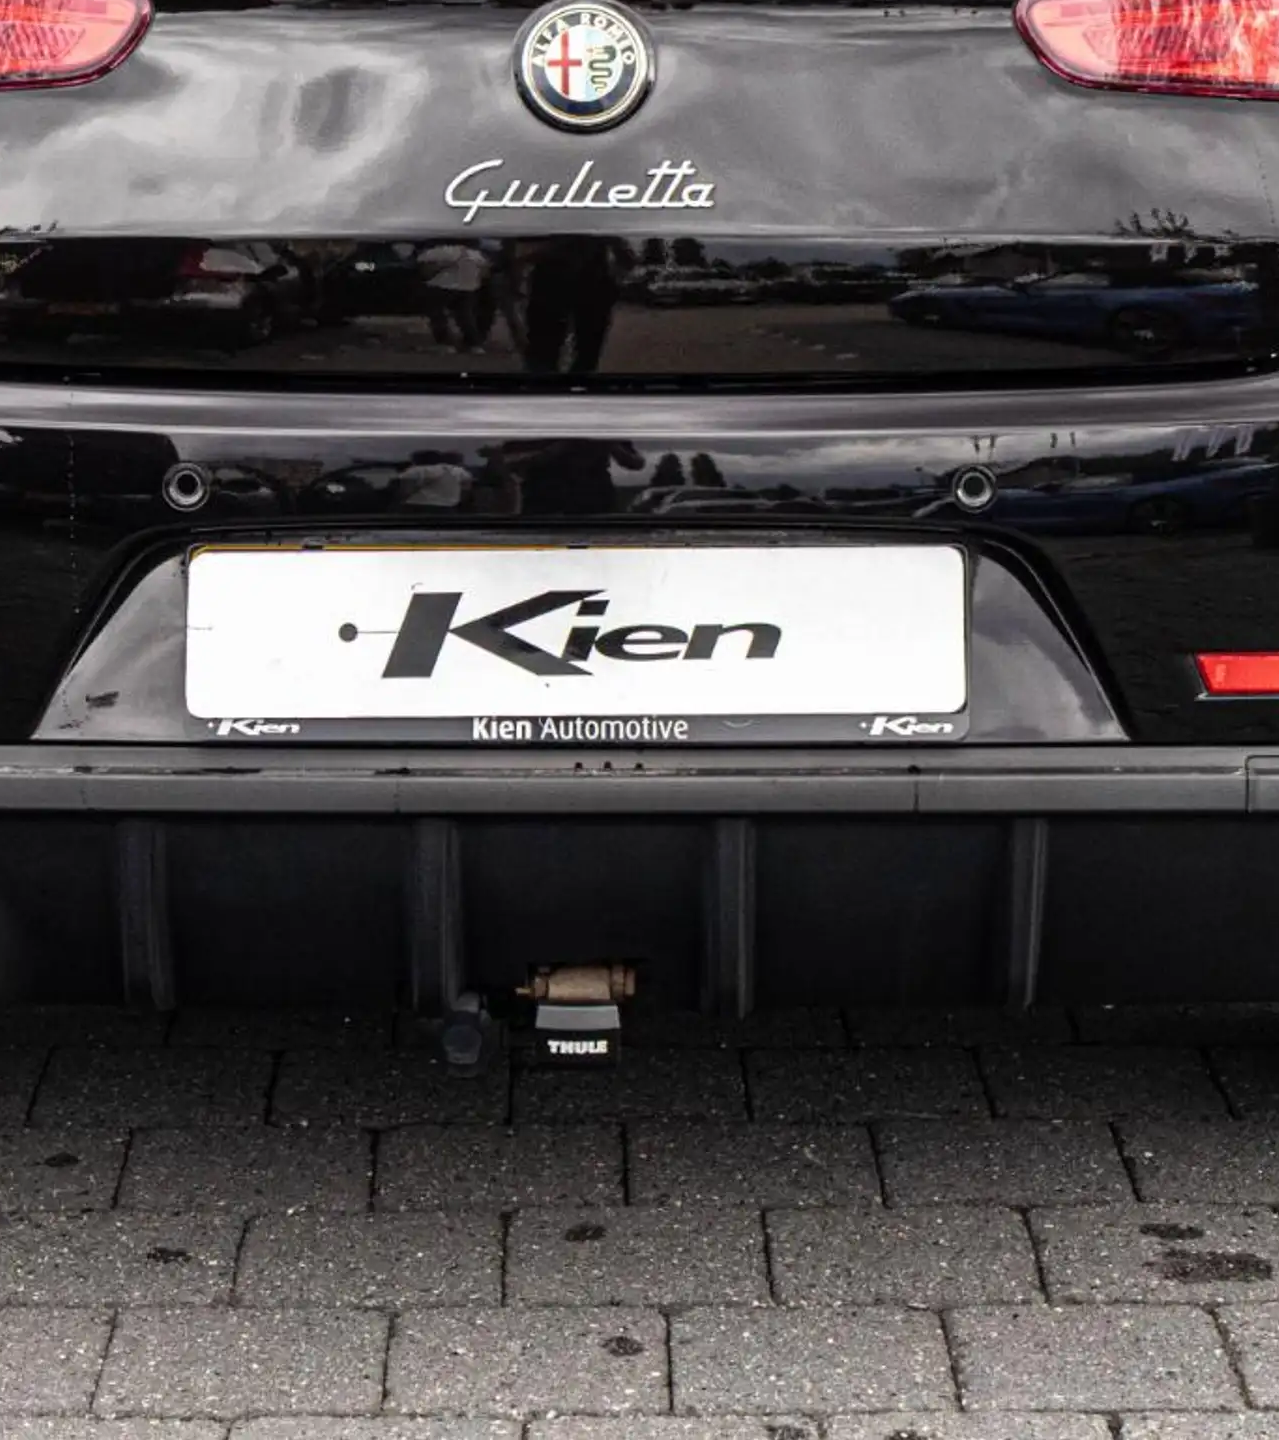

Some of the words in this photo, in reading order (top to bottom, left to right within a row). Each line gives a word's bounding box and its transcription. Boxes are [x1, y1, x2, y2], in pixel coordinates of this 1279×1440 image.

[532, 17, 570, 67] ALFA
[579, 12, 635, 65] ROMEO
[444, 159, 715, 223] Giulietta
[381, 588, 782, 679] Kien
[215, 718, 301, 736] Kien
[472, 717, 532, 740] Kien
[540, 715, 690, 740] Automotive
[869, 716, 954, 736] Kien
[547, 1040, 608, 1054] THULE
